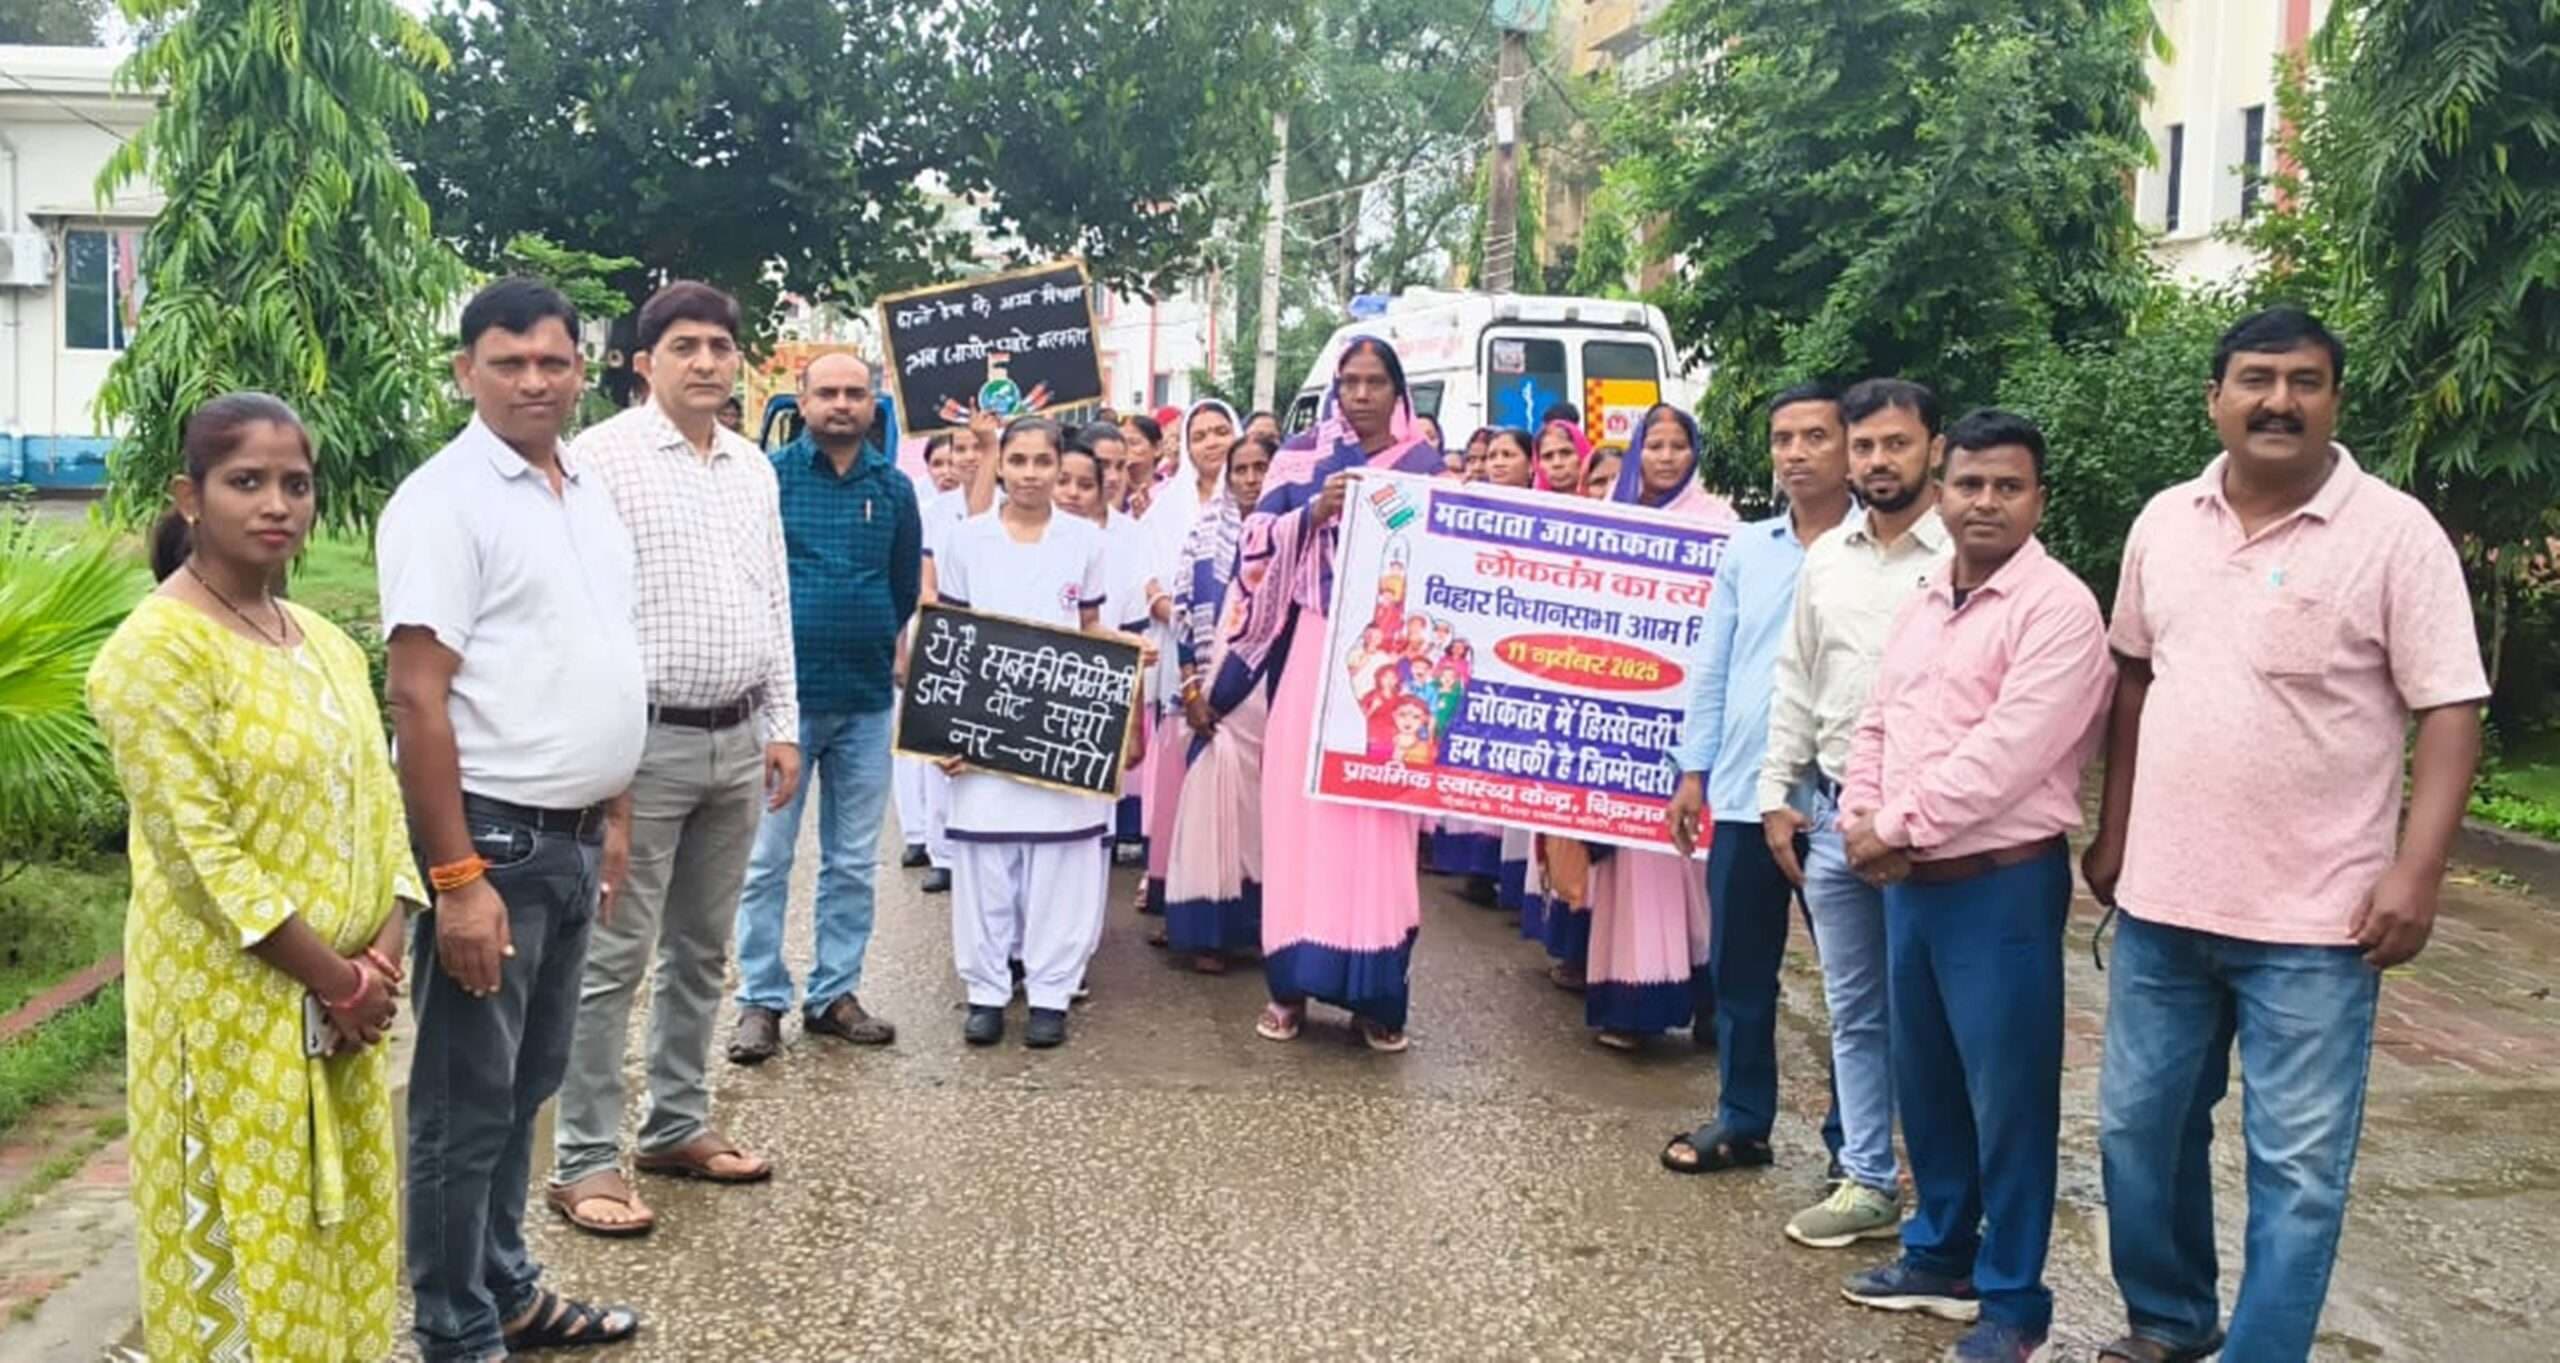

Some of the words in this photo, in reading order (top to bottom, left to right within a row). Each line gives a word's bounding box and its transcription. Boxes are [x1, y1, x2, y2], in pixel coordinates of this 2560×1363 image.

[1434, 502, 1536, 540] मतदाता
[1475, 549, 1606, 592] लोकतंत्र
[1612, 573, 1660, 601] का
[1425, 574, 1494, 616] बिहार
[1496, 585, 1625, 636] विधानसभा
[1628, 614, 1682, 643] आम
[925, 618, 956, 667] ये
[956, 624, 977, 675] है
[1507, 641, 1527, 663] 11
[1610, 655, 1660, 681] 2025
[985, 682, 1034, 721] वोट
[1043, 701, 1115, 744] सभी
[1467, 684, 1551, 734] लोकतंत्र
[1554, 698, 1580, 738] में
[1580, 702, 1677, 750] हिस्सेदारी
[1343, 760, 1434, 790] प्राथमिक
[1448, 733, 1488, 766] हम
[1488, 736, 1554, 777] सबकी
[1554, 742, 1576, 780] है
